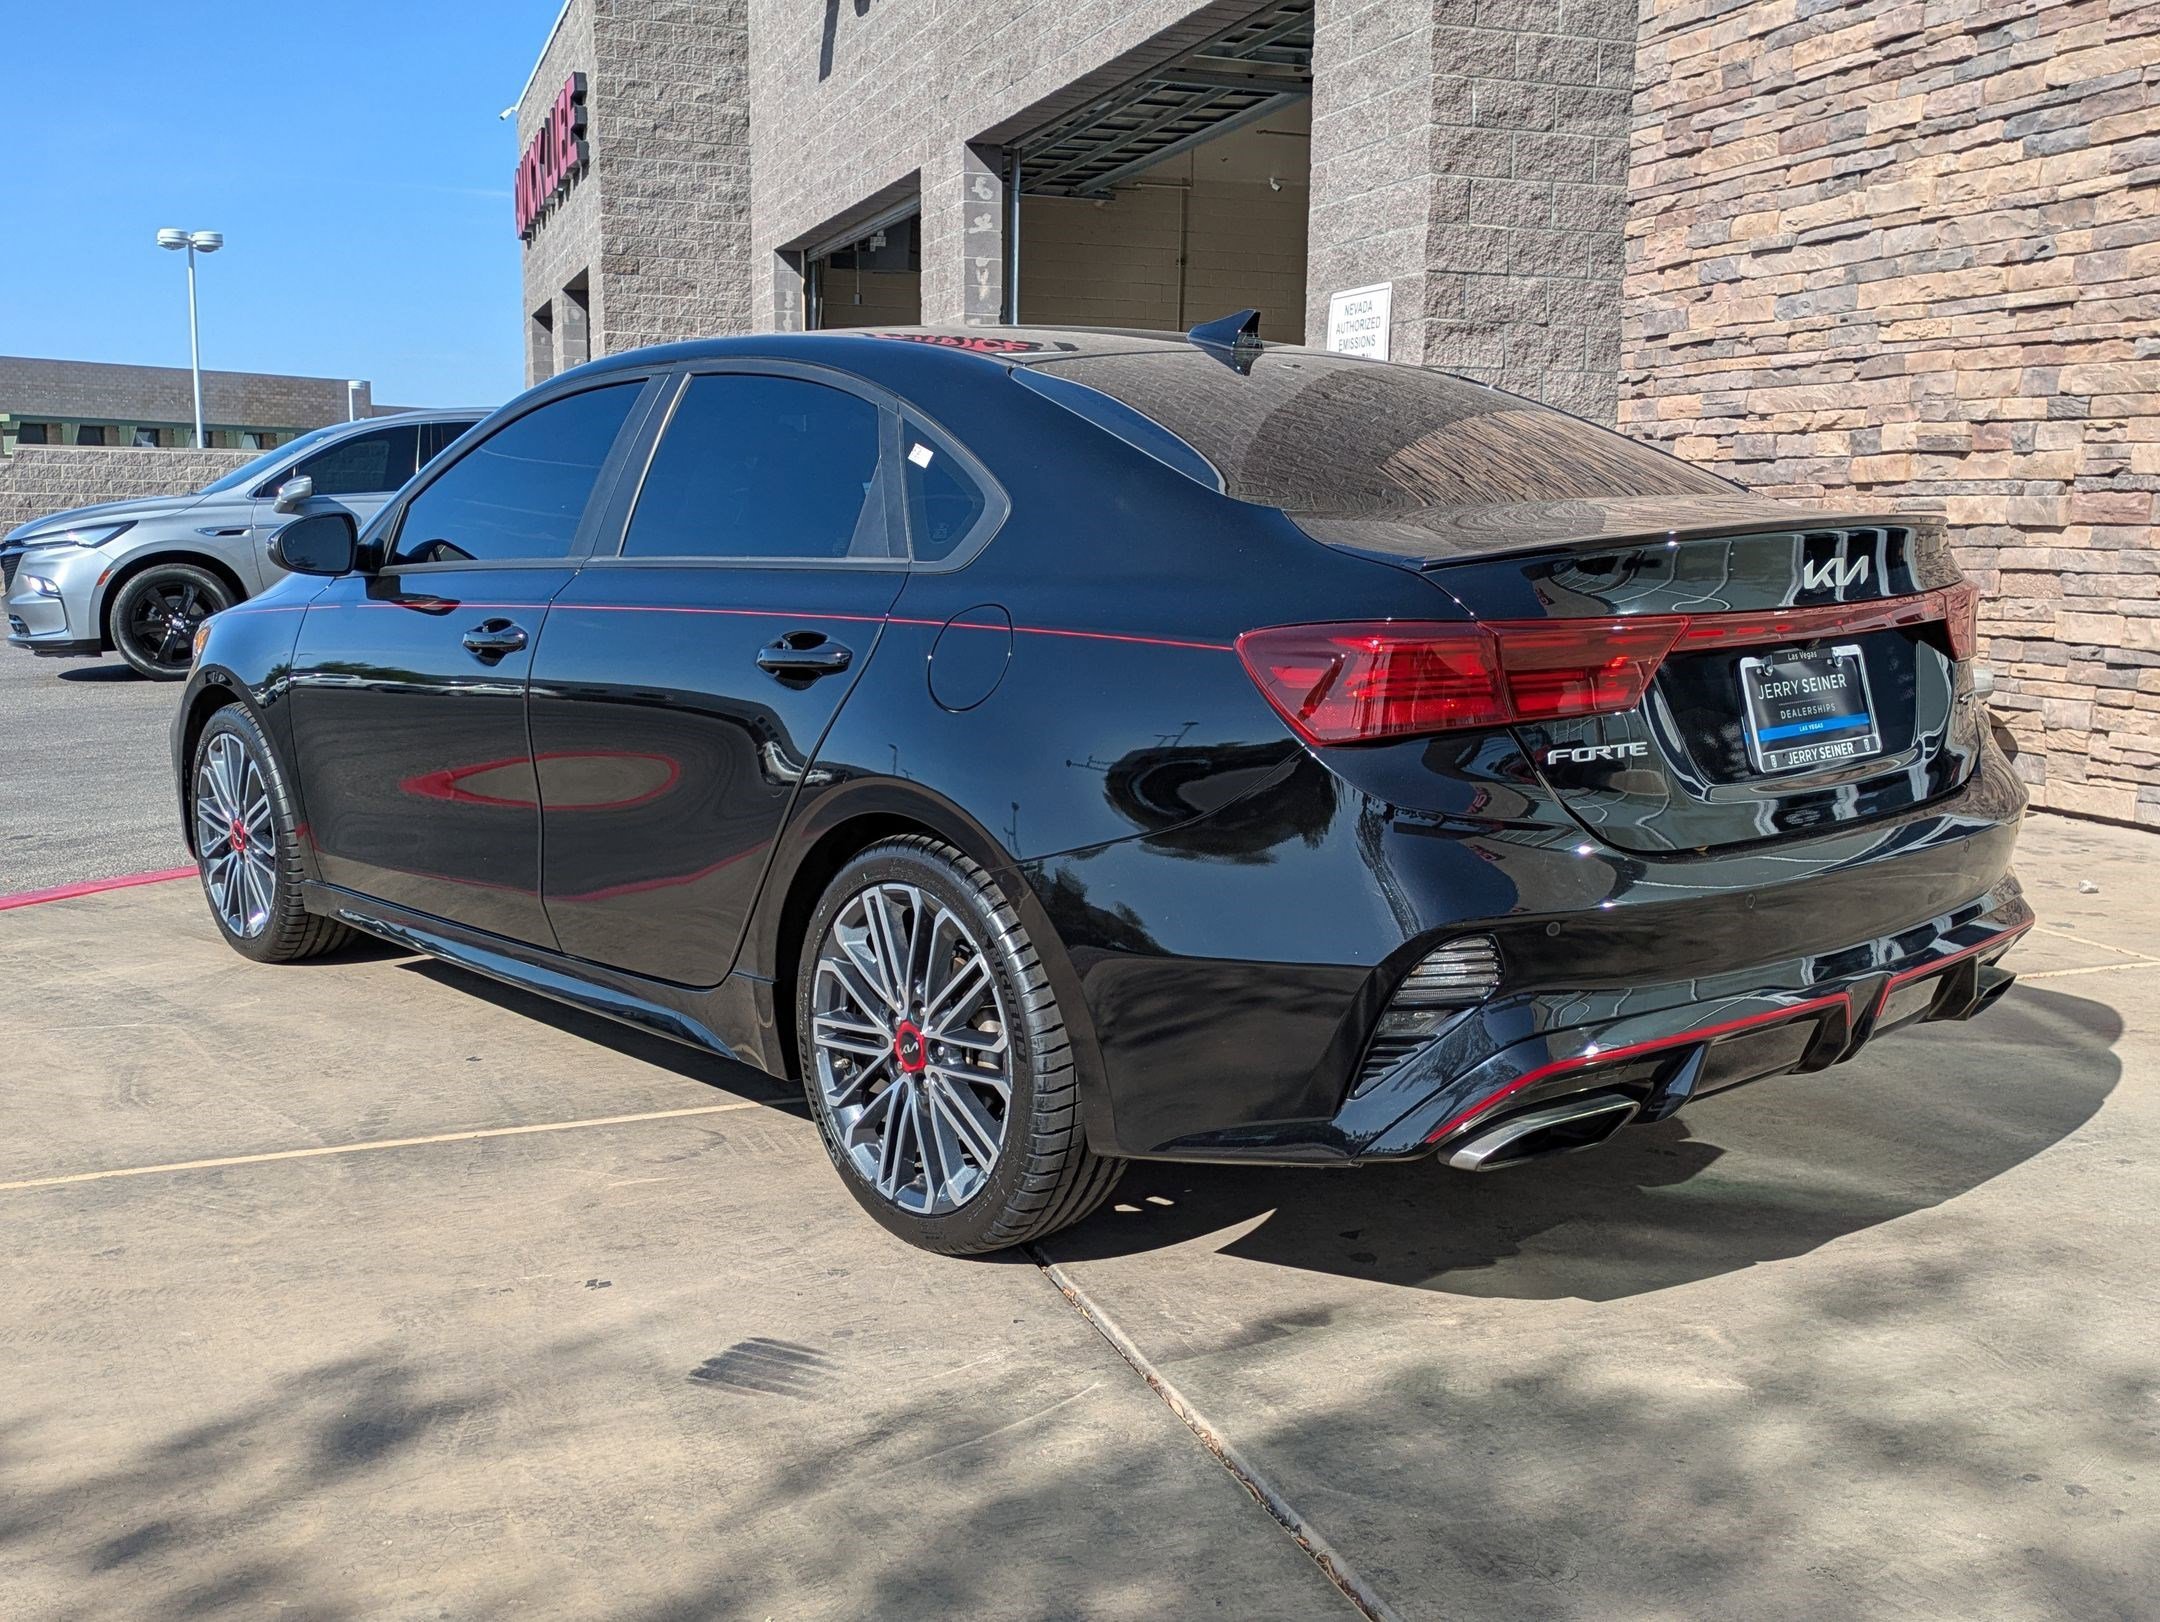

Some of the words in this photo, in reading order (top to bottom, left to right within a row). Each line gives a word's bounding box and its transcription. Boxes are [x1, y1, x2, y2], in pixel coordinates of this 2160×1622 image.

[514, 127, 545, 240] QUICK
[544, 71, 582, 198] LUBE
[1344, 300, 1373, 316] NEVADA
[1336, 316, 1381, 335] AUTHORIZED
[1338, 334, 1376, 352] EMISSIONS
[1787, 653, 1799, 661] Las
[1799, 650, 1818, 660] Vegas
[1758, 680, 1799, 700] JERRY
[1801, 673, 1848, 693] SEINER
[1780, 703, 1836, 720] DEALERSHIPS
[1808, 722, 1824, 731] VEGAS
[1547, 741, 1649, 765] FORTE
[1788, 748, 1818, 765] JERRY
[1819, 742, 1855, 760] SEINER
